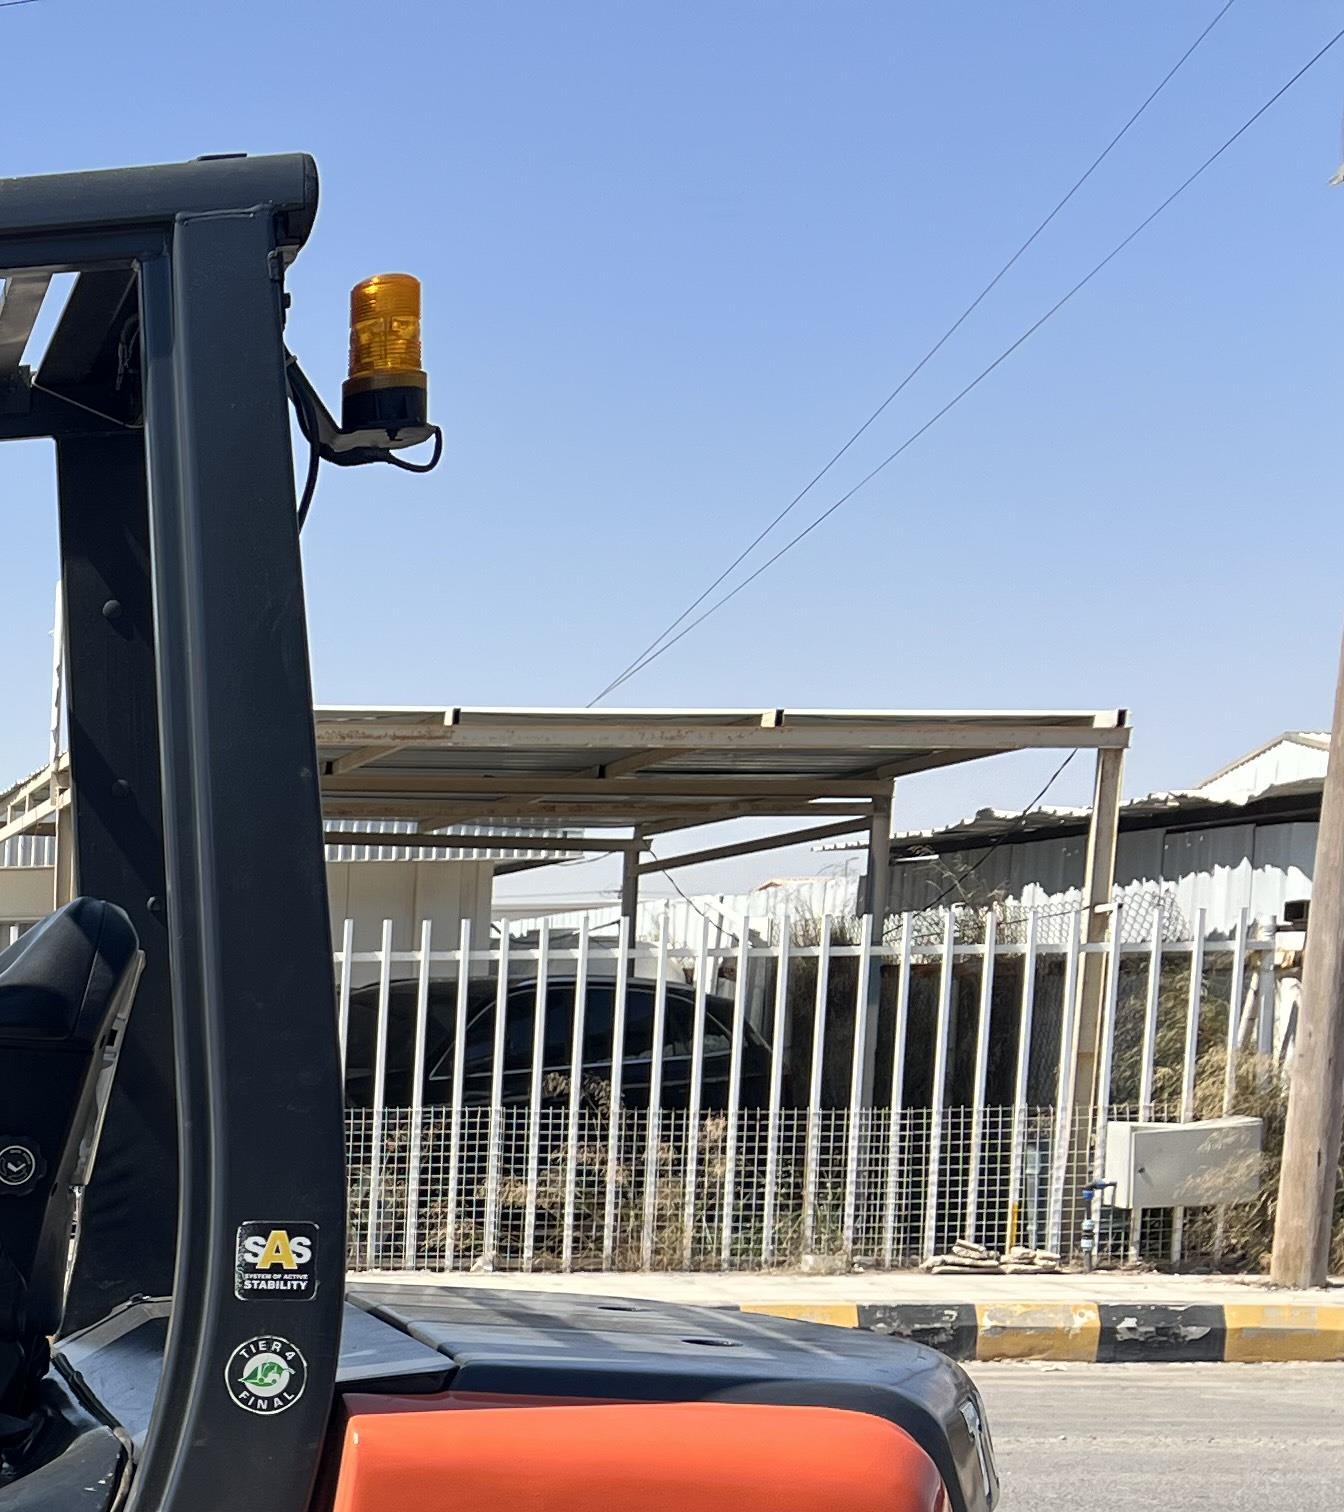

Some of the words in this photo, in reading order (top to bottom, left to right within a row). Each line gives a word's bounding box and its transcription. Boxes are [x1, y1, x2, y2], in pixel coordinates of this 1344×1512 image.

[243, 1230, 312, 1270] SAS
[243, 1280, 309, 1290] STABILITY
[239, 1340, 283, 1359] TIER
[285, 1350, 296, 1361] 4
[238, 1390, 295, 1410] FINAL
